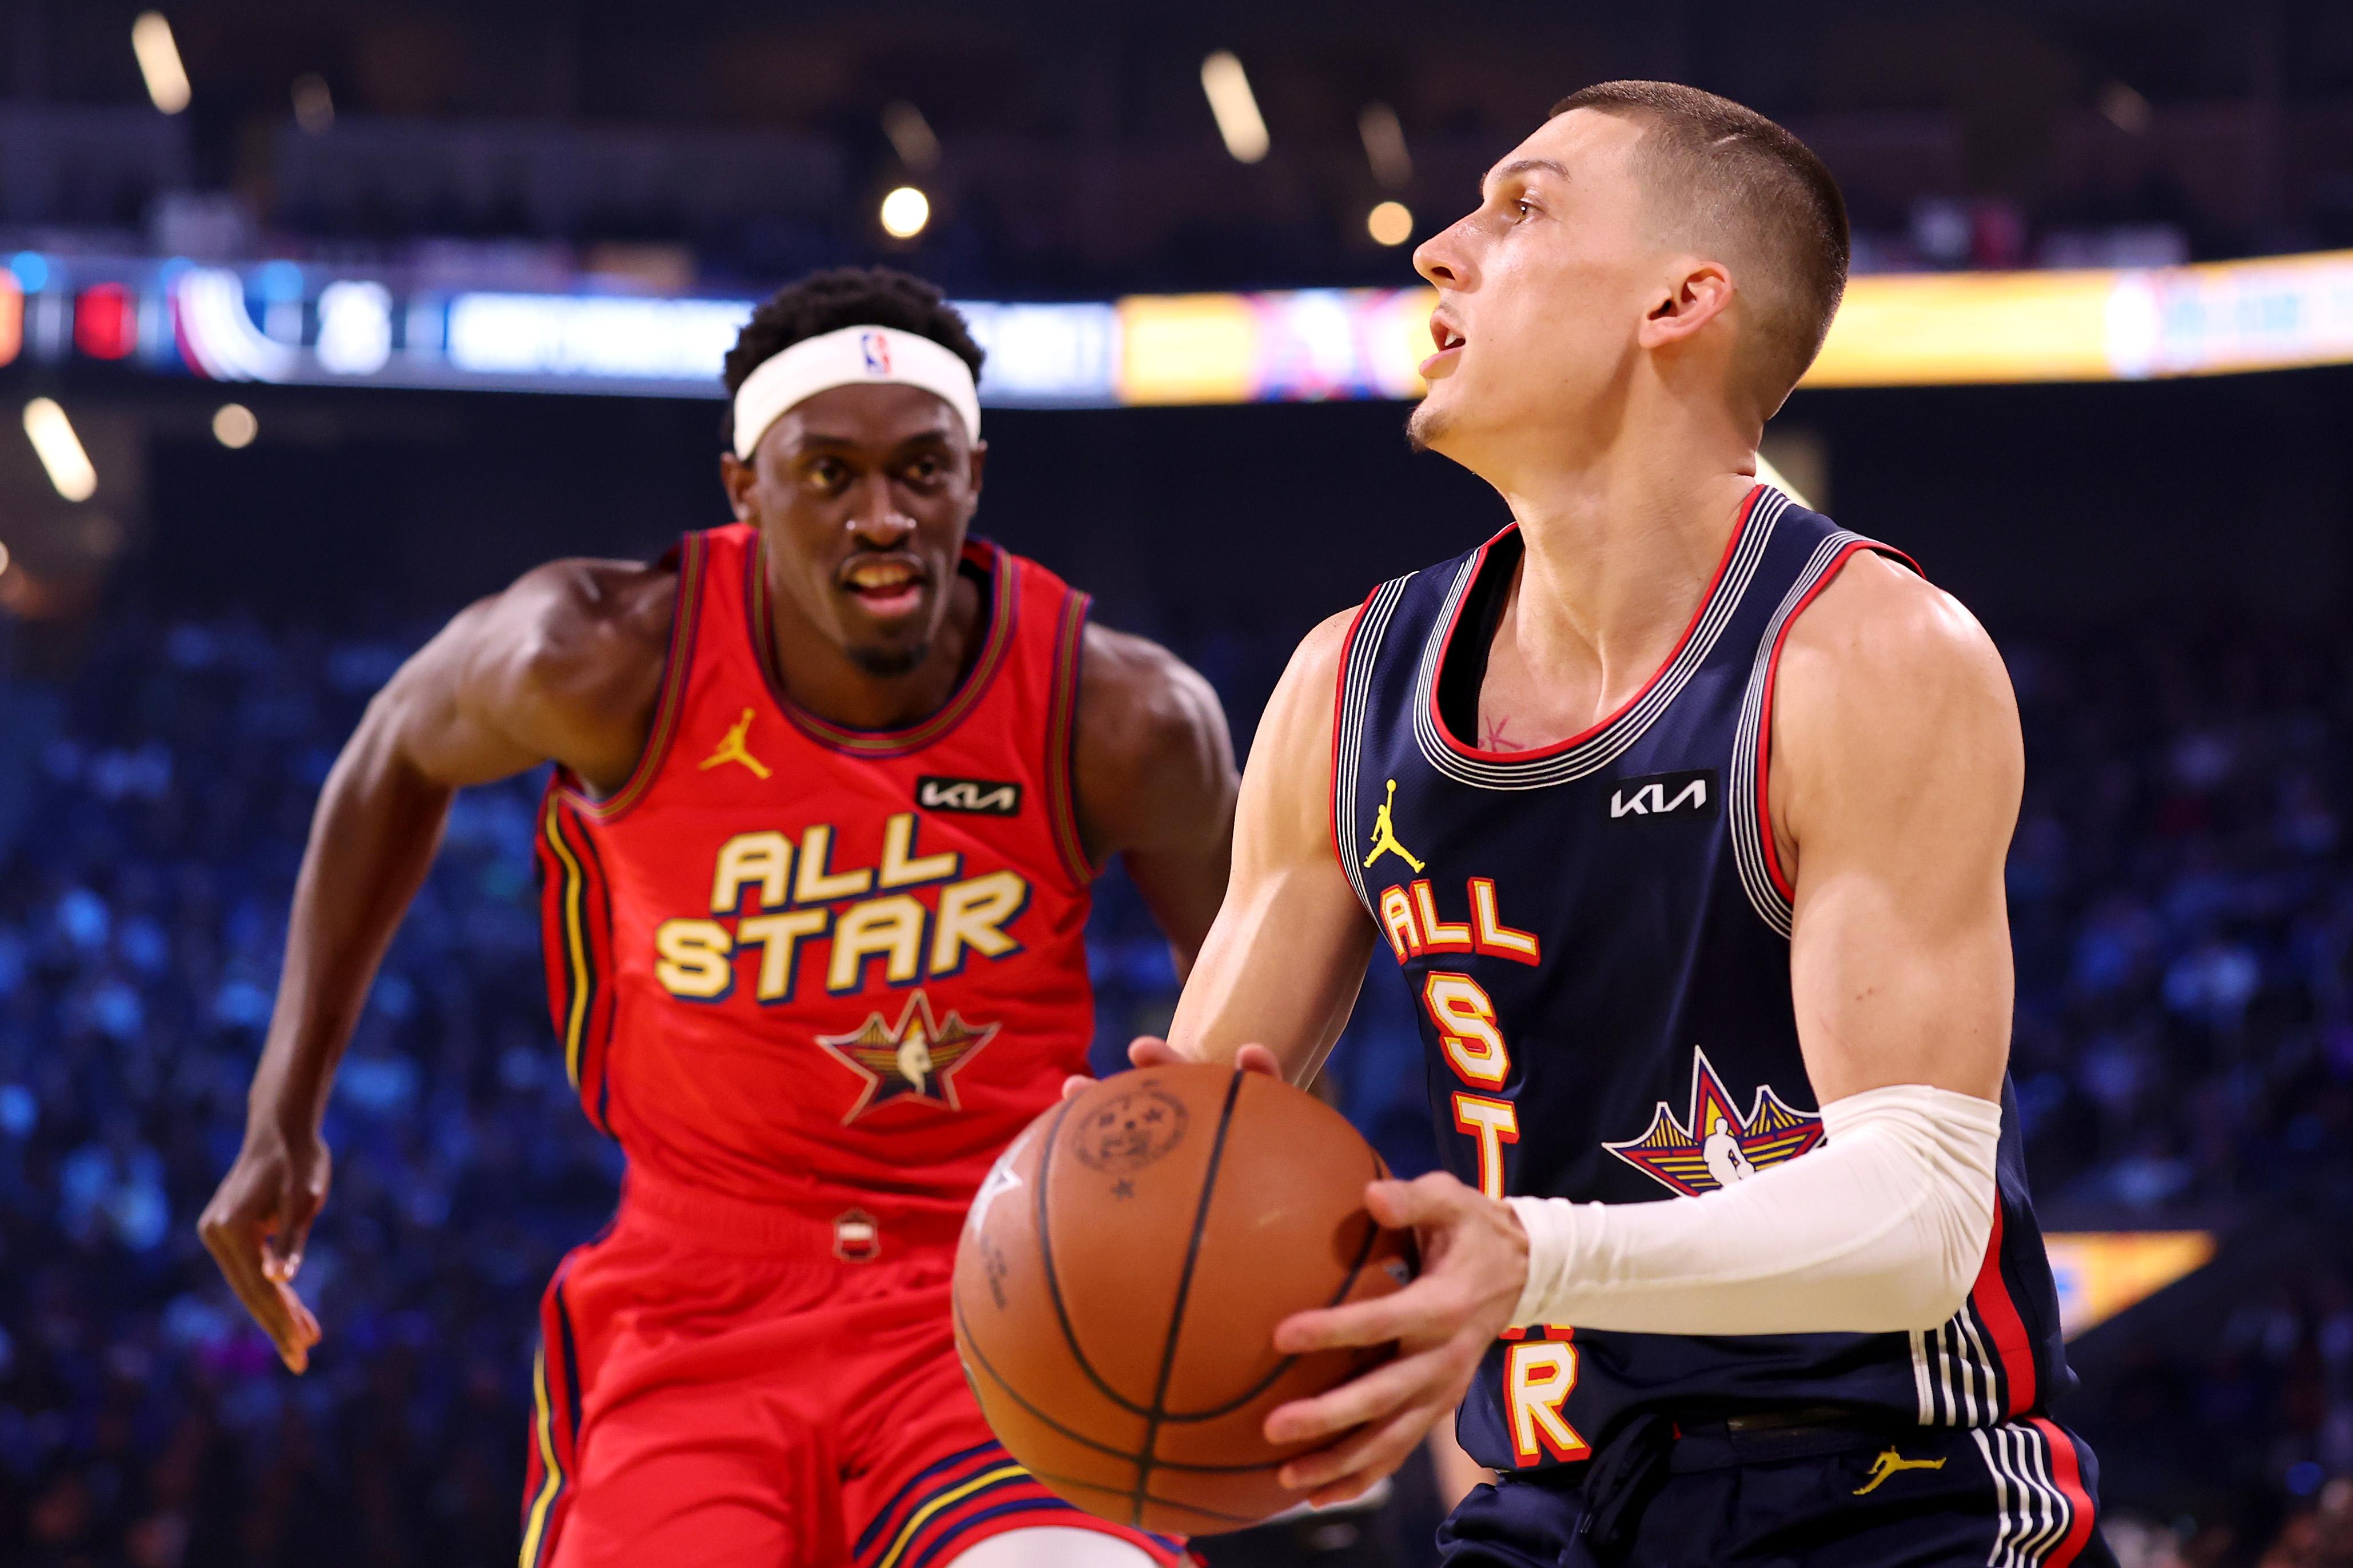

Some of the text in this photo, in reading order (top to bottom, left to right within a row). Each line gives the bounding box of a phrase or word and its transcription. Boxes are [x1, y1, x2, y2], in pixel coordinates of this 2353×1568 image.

[922, 781, 1017, 811] KIA
[1610, 778, 1707, 819] KIA
[710, 812, 964, 915] ALL
[654, 869, 1032, 1007] STAR
[1379, 877, 1541, 967] ALL
[1423, 971, 1592, 1468] STR
